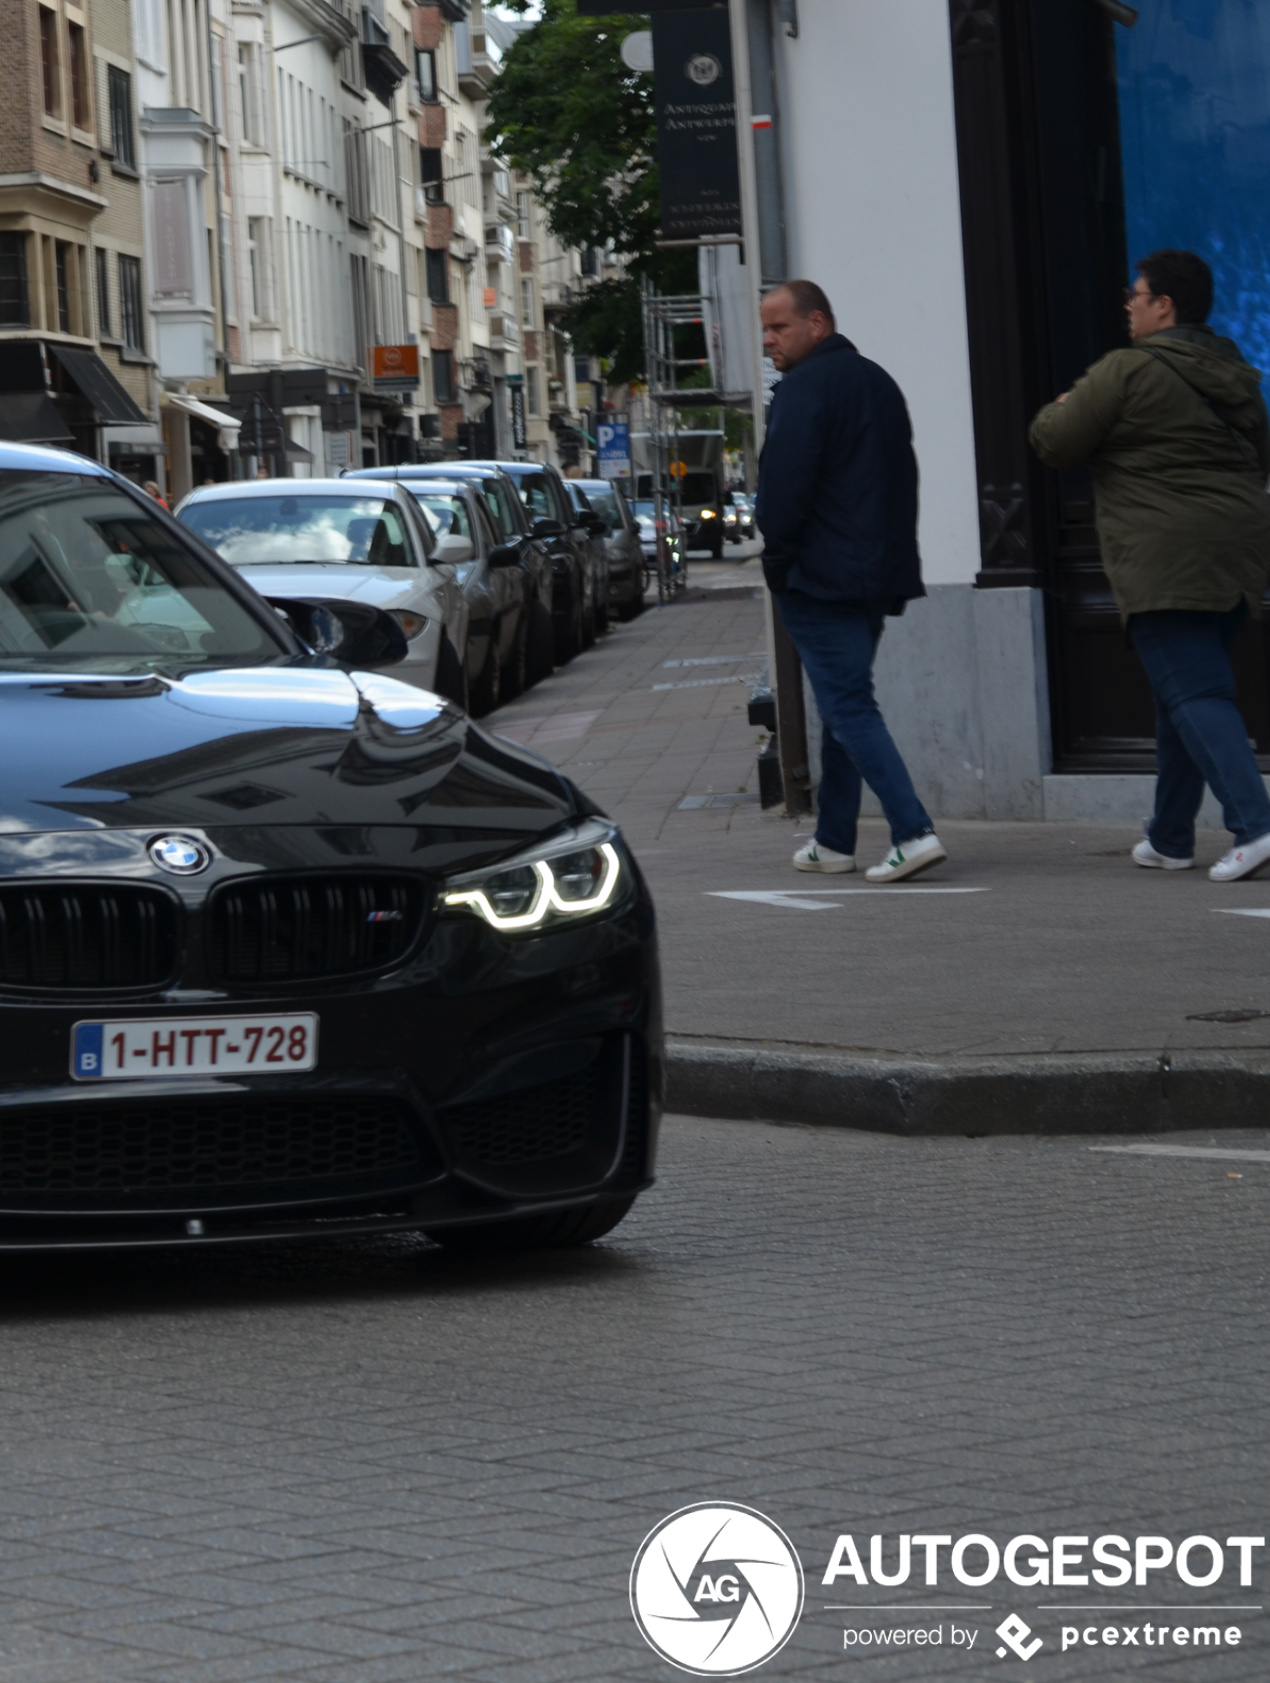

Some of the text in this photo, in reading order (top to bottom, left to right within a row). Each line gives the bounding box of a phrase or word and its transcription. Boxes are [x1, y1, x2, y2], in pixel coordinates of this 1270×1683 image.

[597, 426, 615, 448] P
[111, 1025, 308, 1069] 1-HTT-728
[80, 1053, 98, 1071] B
